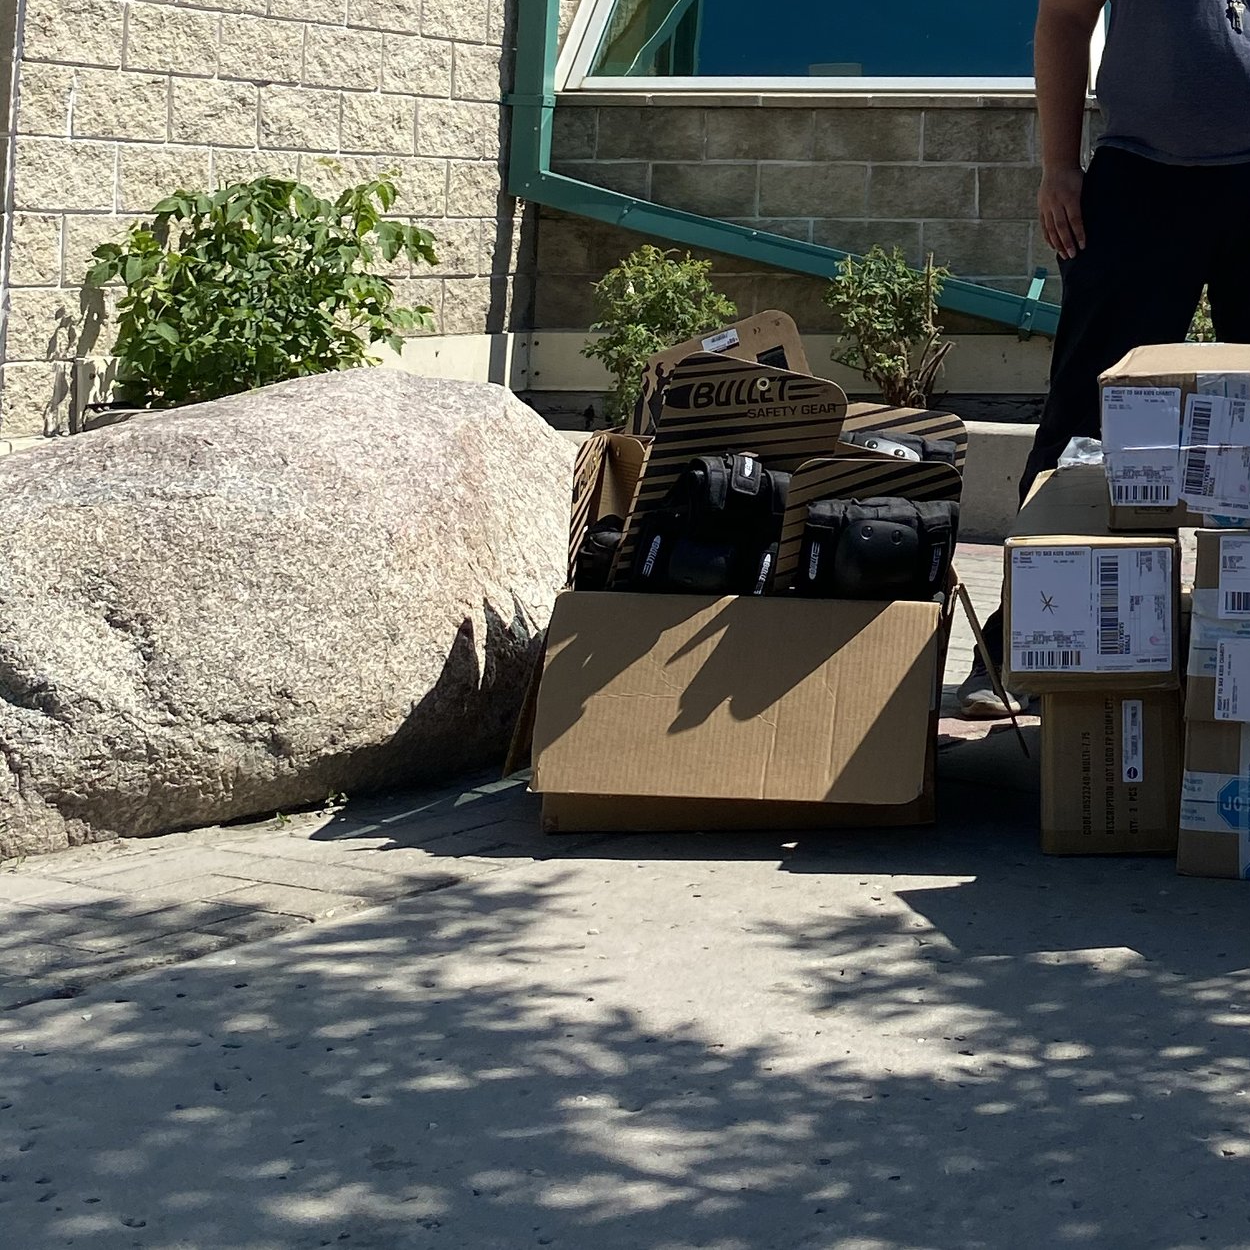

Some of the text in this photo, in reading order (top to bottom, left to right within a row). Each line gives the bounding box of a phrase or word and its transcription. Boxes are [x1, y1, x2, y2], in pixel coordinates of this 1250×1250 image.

[690, 375, 794, 408] BULLET
[747, 403, 837, 419] SAFETY GEAR
